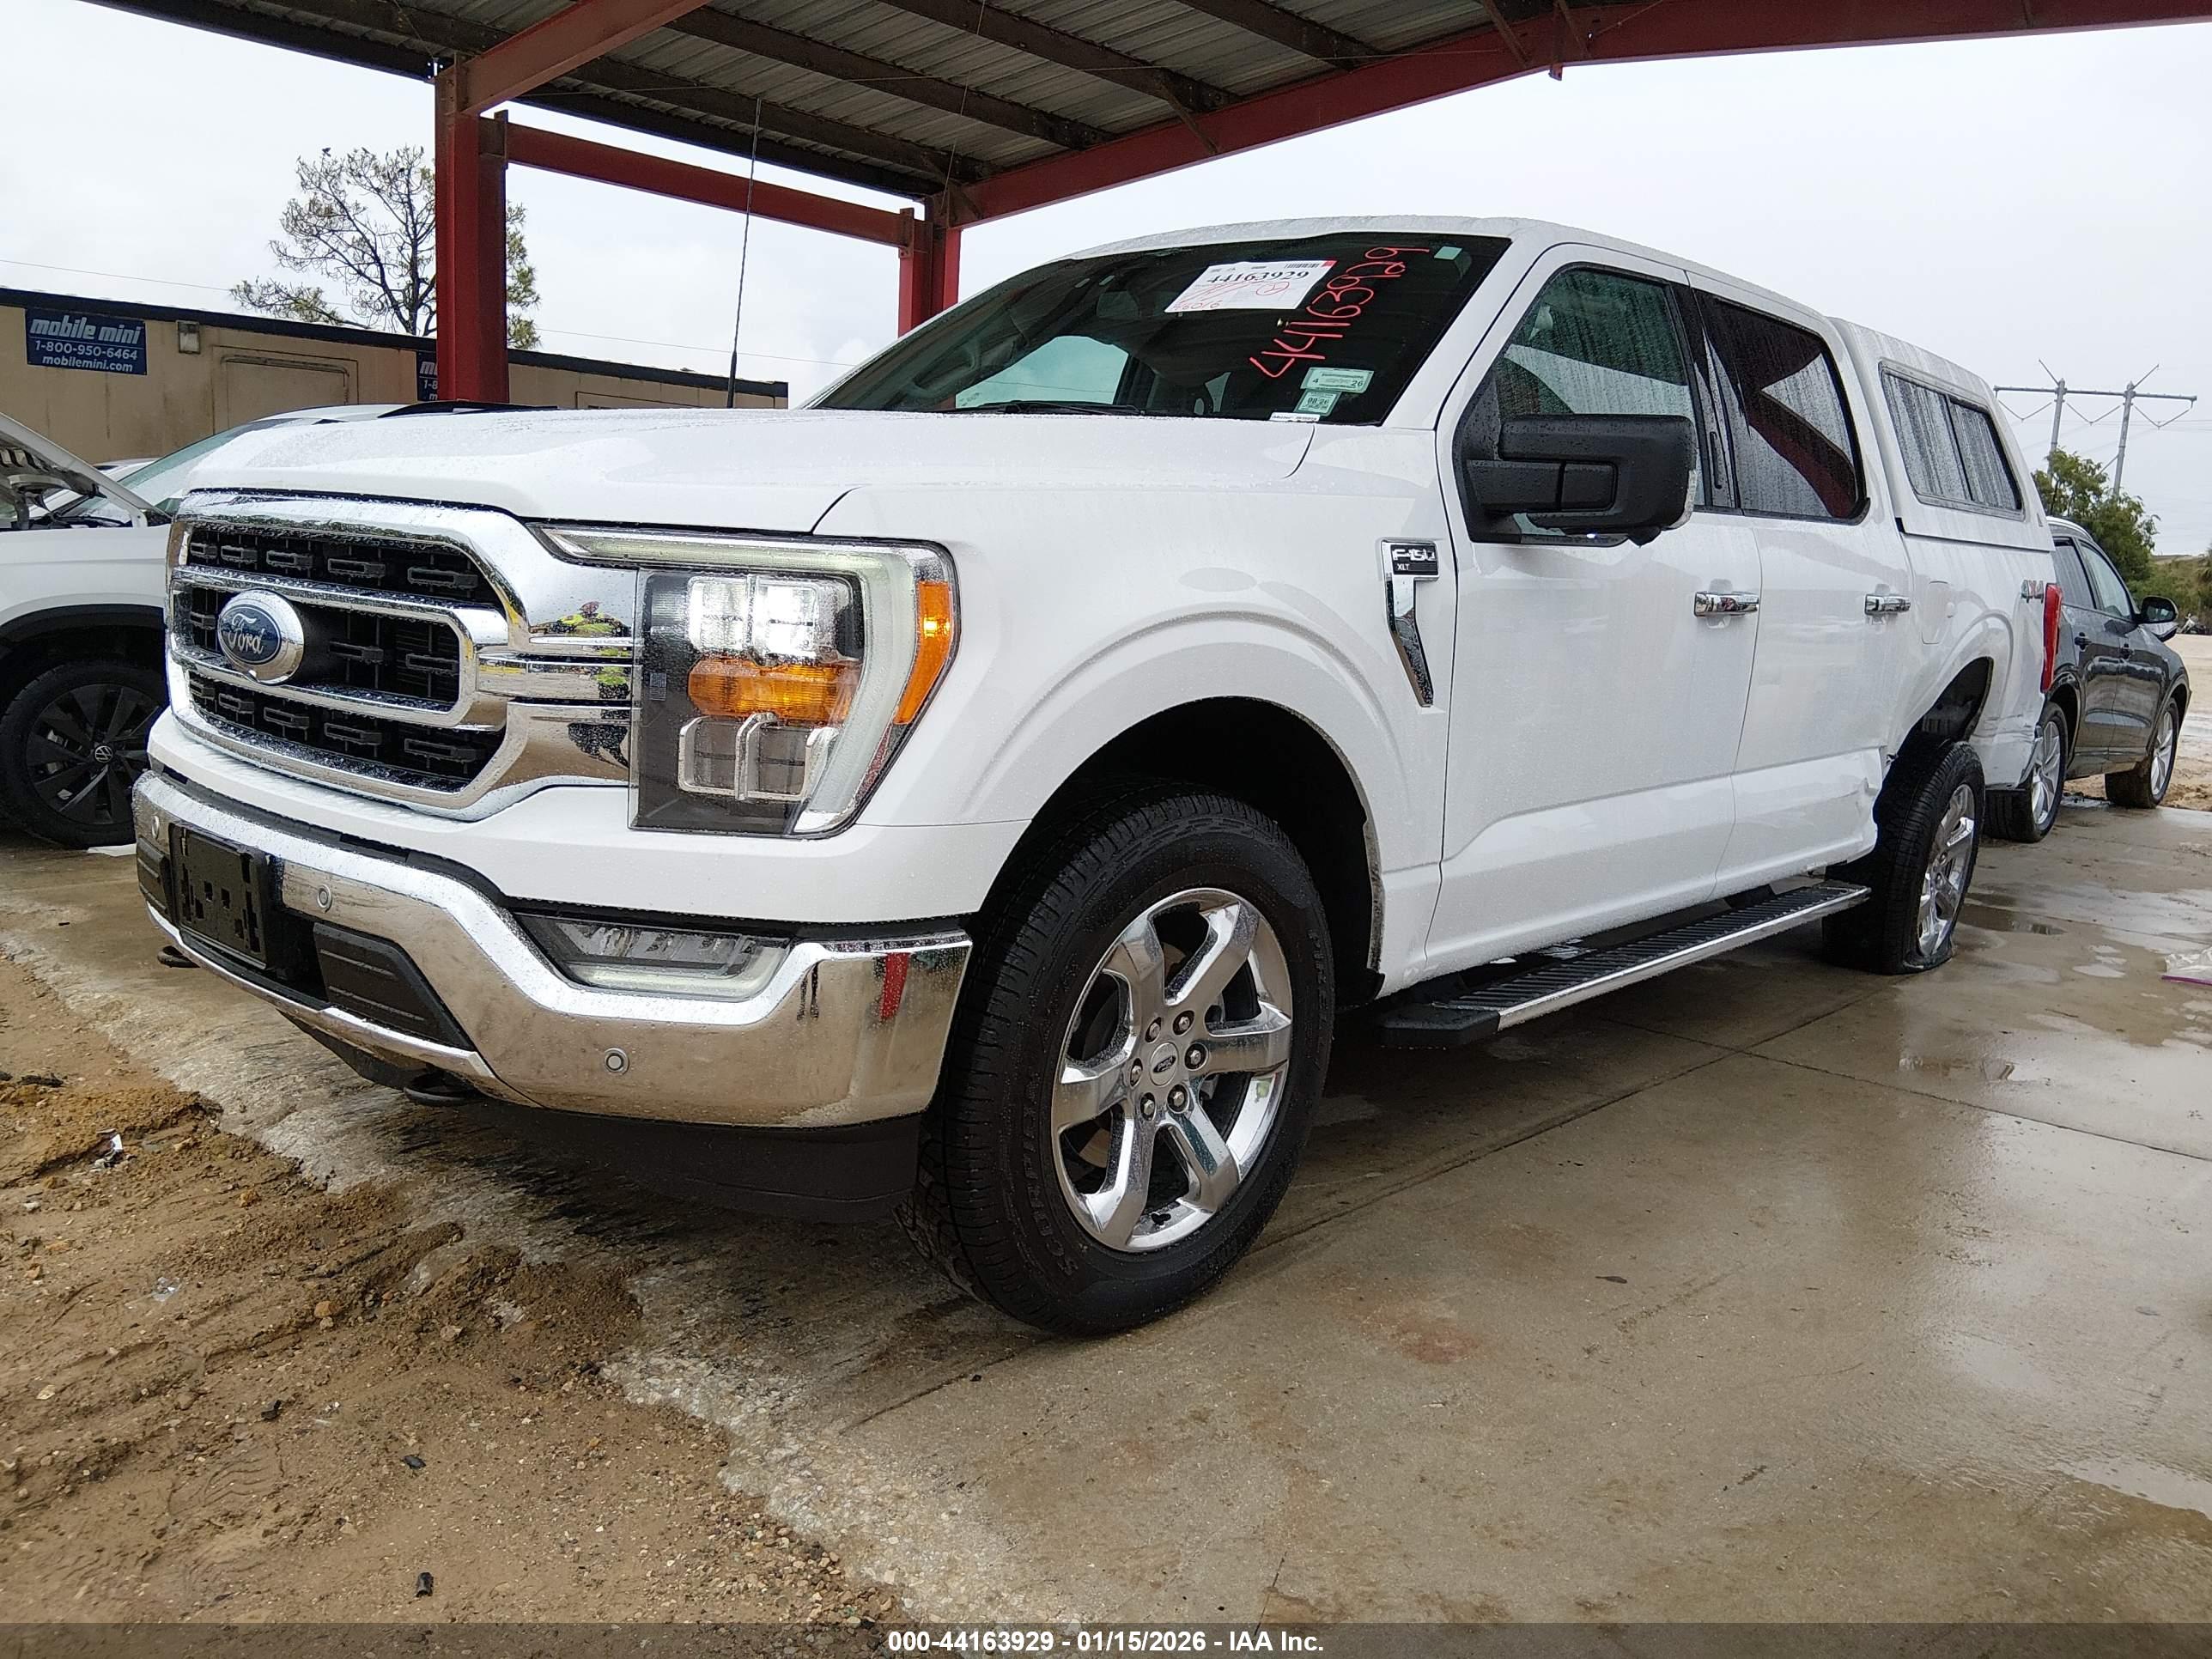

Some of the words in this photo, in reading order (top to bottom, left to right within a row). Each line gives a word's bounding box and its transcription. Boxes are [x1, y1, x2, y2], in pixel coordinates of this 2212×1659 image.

[1206, 270, 1310, 283] 44163929
[1249, 246, 1430, 378] 44163929
[29, 315, 96, 339] mobile
[98, 325, 141, 343] mini
[34, 340, 137, 360] 1-800-950-6464
[42, 356, 133, 372] mobilemini.com
[1391, 549, 1436, 561] F-150
[227, 612, 265, 655] Ford
